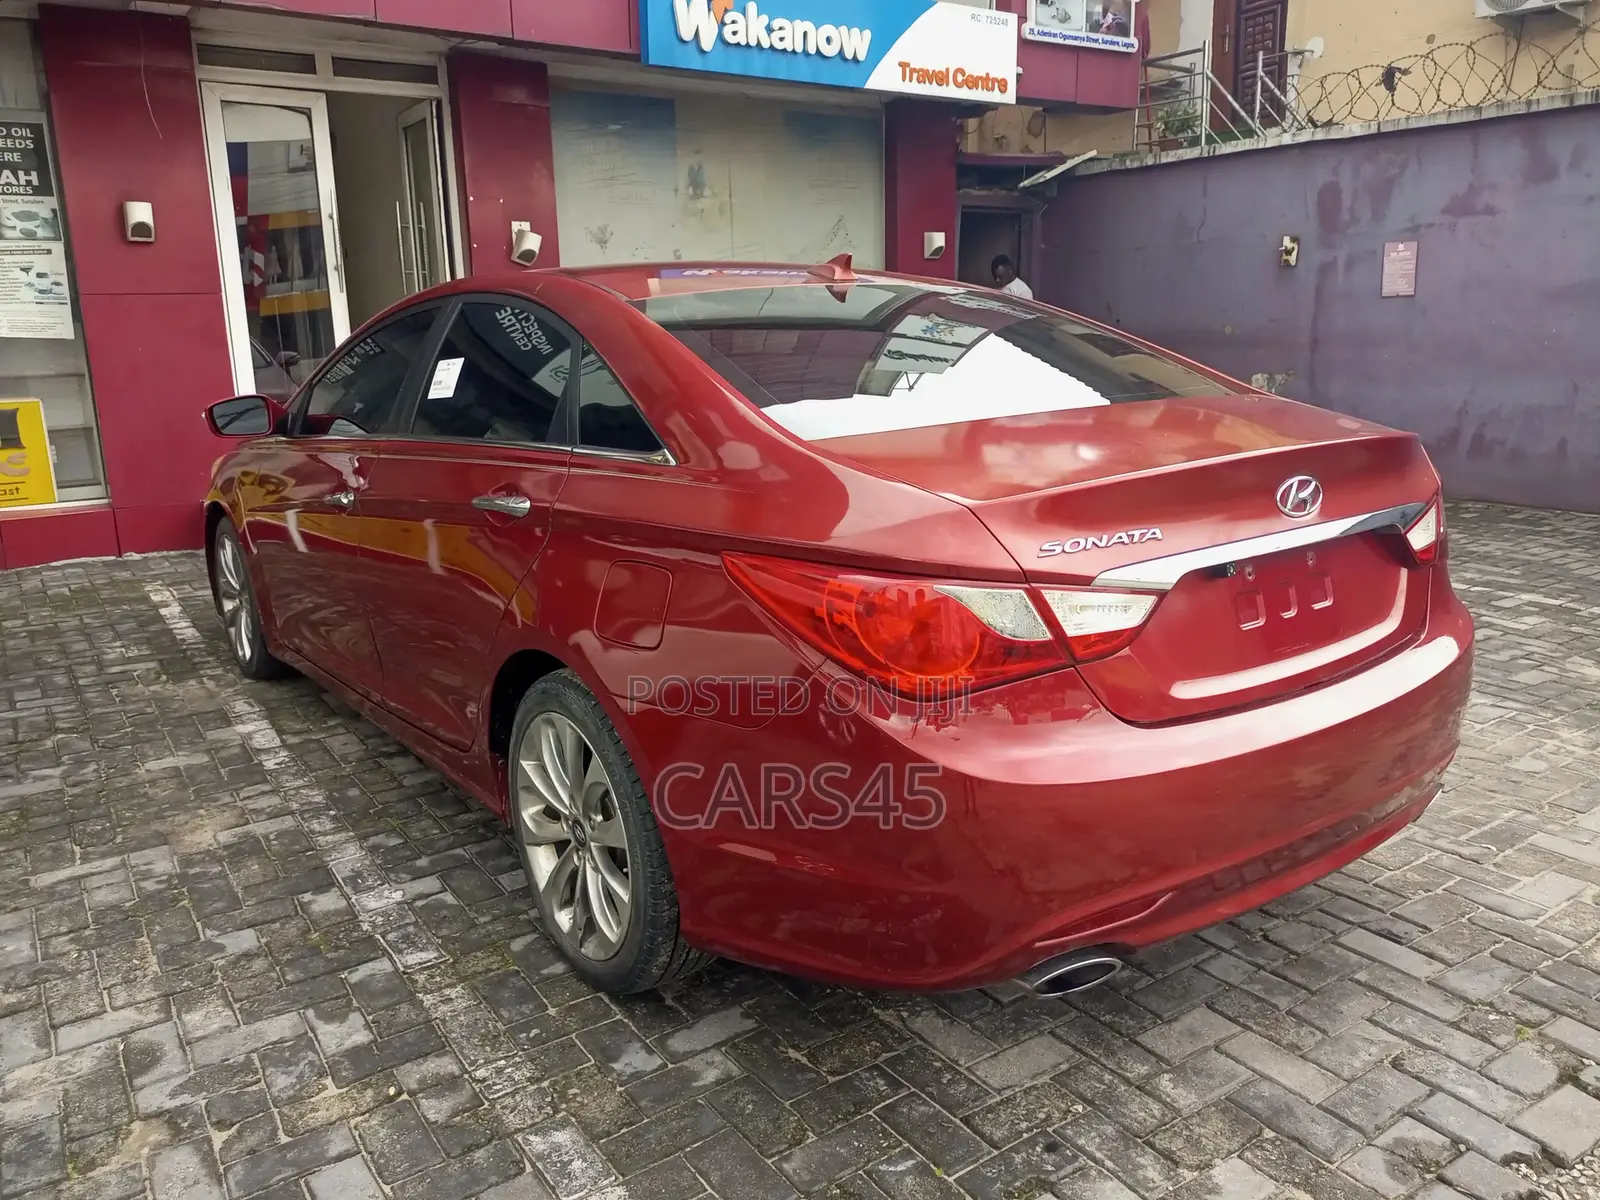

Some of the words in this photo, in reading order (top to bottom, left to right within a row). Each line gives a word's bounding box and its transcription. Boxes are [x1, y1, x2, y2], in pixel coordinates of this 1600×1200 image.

[673, 0, 872, 62] Wakanow
[986, 15, 1008, 27] 725248
[898, 61, 950, 87] Travel
[953, 67, 1008, 94] Centre
[11, 127, 35, 138] OIL
[1037, 527, 1163, 558] SONATA
